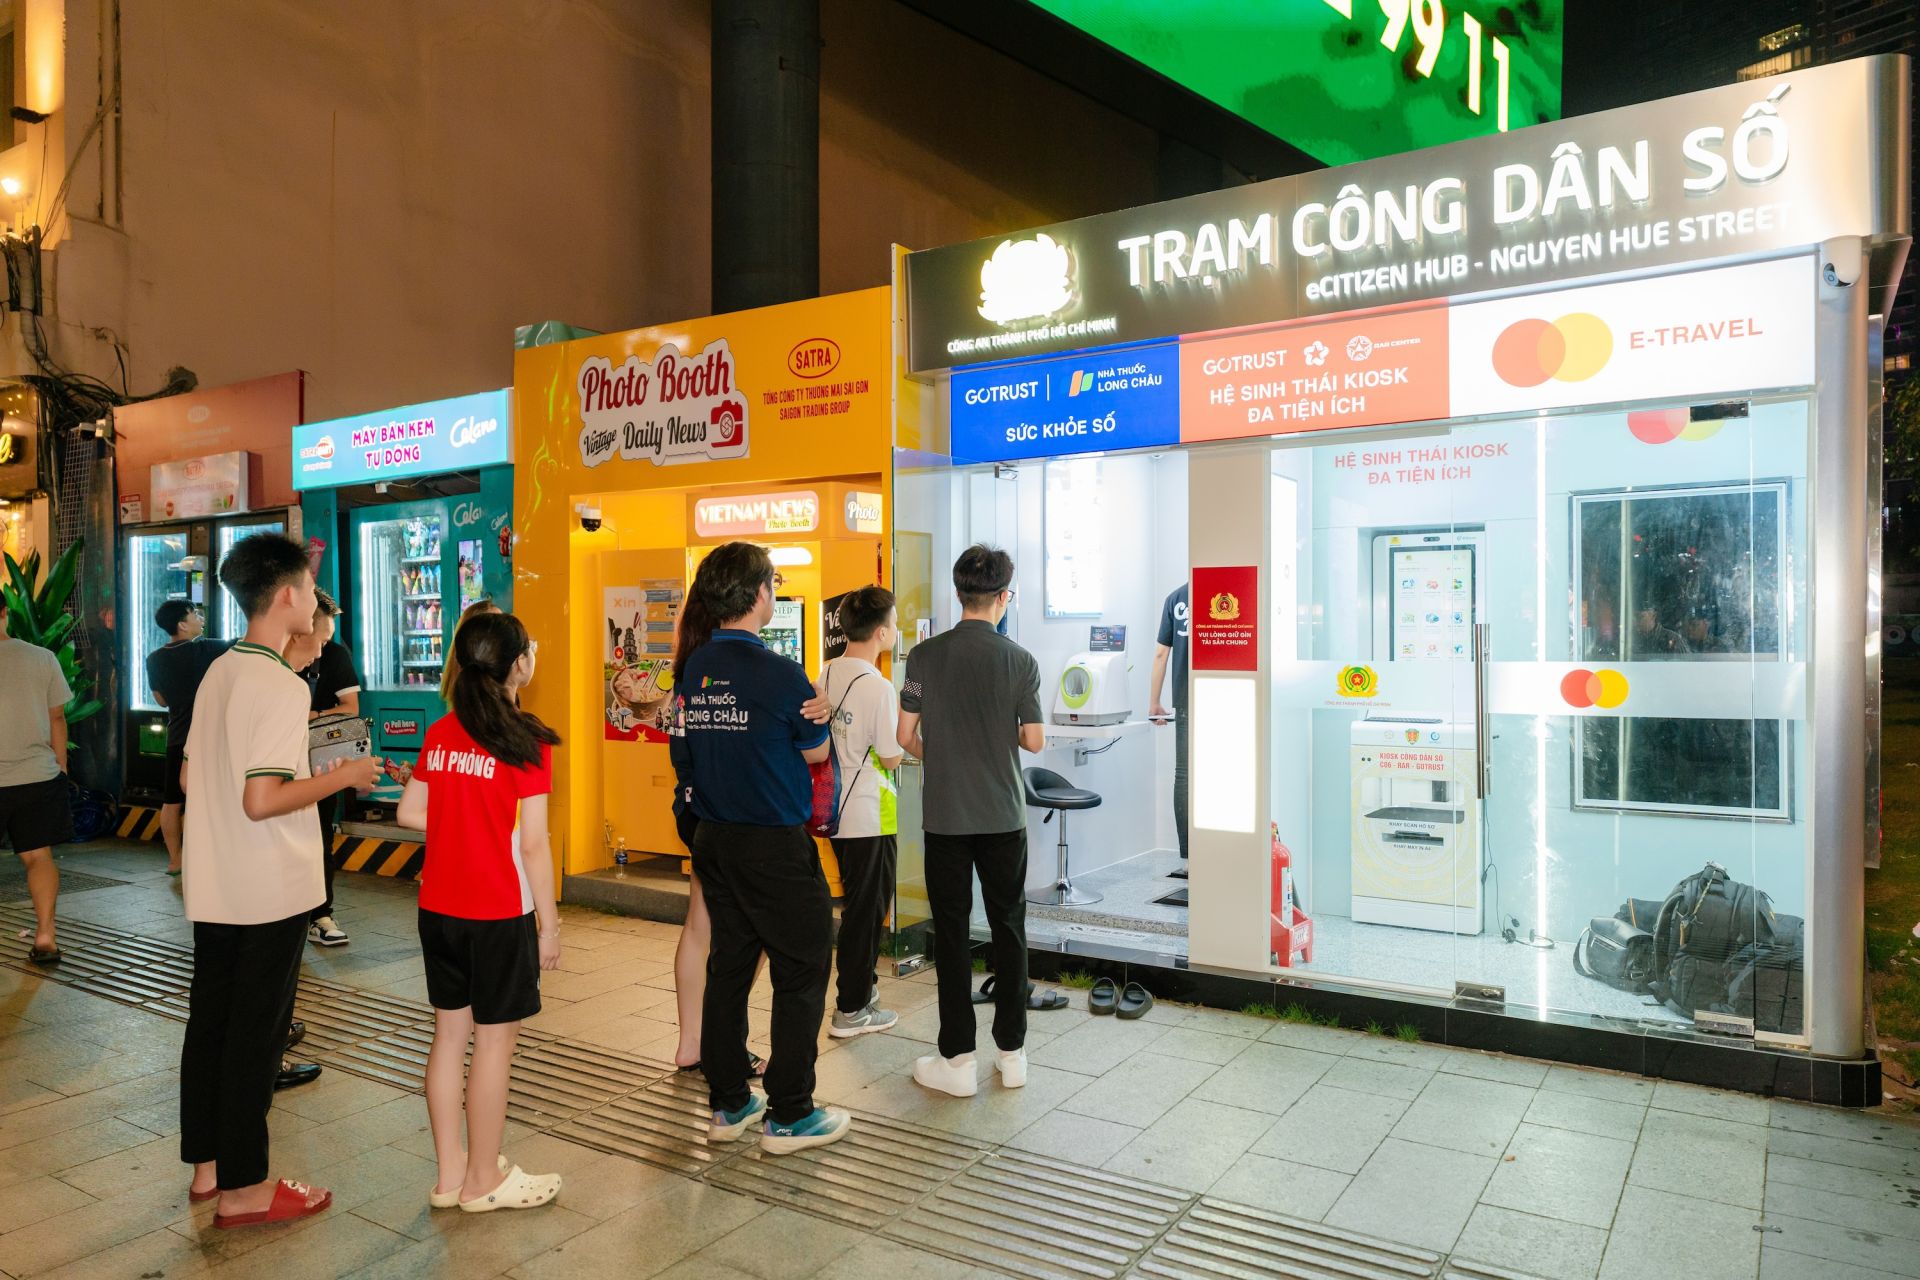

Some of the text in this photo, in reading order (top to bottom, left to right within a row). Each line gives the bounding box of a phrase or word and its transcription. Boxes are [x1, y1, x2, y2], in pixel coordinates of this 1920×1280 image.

[1118, 83, 1791, 287] TRẠM CÔNG DÂN SỐ
[1306, 263, 1408, 299] eCITIZEN
[1415, 254, 1468, 284] HUB
[1490, 232, 1602, 272] NGUYEN
[1609, 221, 1671, 252] HUE
[1679, 203, 1794, 243] STREET
[947, 317, 1116, 353] CÔNG AN THÀNH PHỐ HỒ CHÍ MINH
[1630, 318, 1763, 350] E-TRAVEL
[796, 347, 831, 370] SATRA
[1098, 362, 1146, 378] NHÀ THUỐC
[1203, 350, 1287, 375] GOTRUST
[582, 350, 730, 412] Photo Booth
[965, 381, 1038, 405] GOTRUST
[1098, 373, 1162, 392] LONG CHÂU
[1210, 367, 1409, 406] HỆ SINH THÁI KIOSK
[780, 400, 850, 420] SAIGON TRADING GROUP
[1247, 395, 1365, 423] ĐA TIỆN ÍCH
[409, 417, 435, 438] KEM
[623, 416, 707, 455] Daily News
[1006, 411, 1116, 442] SỨC KHỎE SỐ
[584, 429, 617, 456] Vintage
[1334, 442, 1509, 470] HỆ SINH THÁI KIOSK
[1368, 464, 1472, 485] ĐA TIỆN ÍCH
[699, 498, 817, 525] VIETNAM NEWS
[847, 501, 880, 521] Photo
[691, 692, 736, 705] NHÀ THUỐC
[713, 707, 748, 724] CHÂU
[426, 744, 443, 772] HẢI
[448, 747, 496, 780] PHÒNG
[1380, 752, 1398, 760] KIOSK
